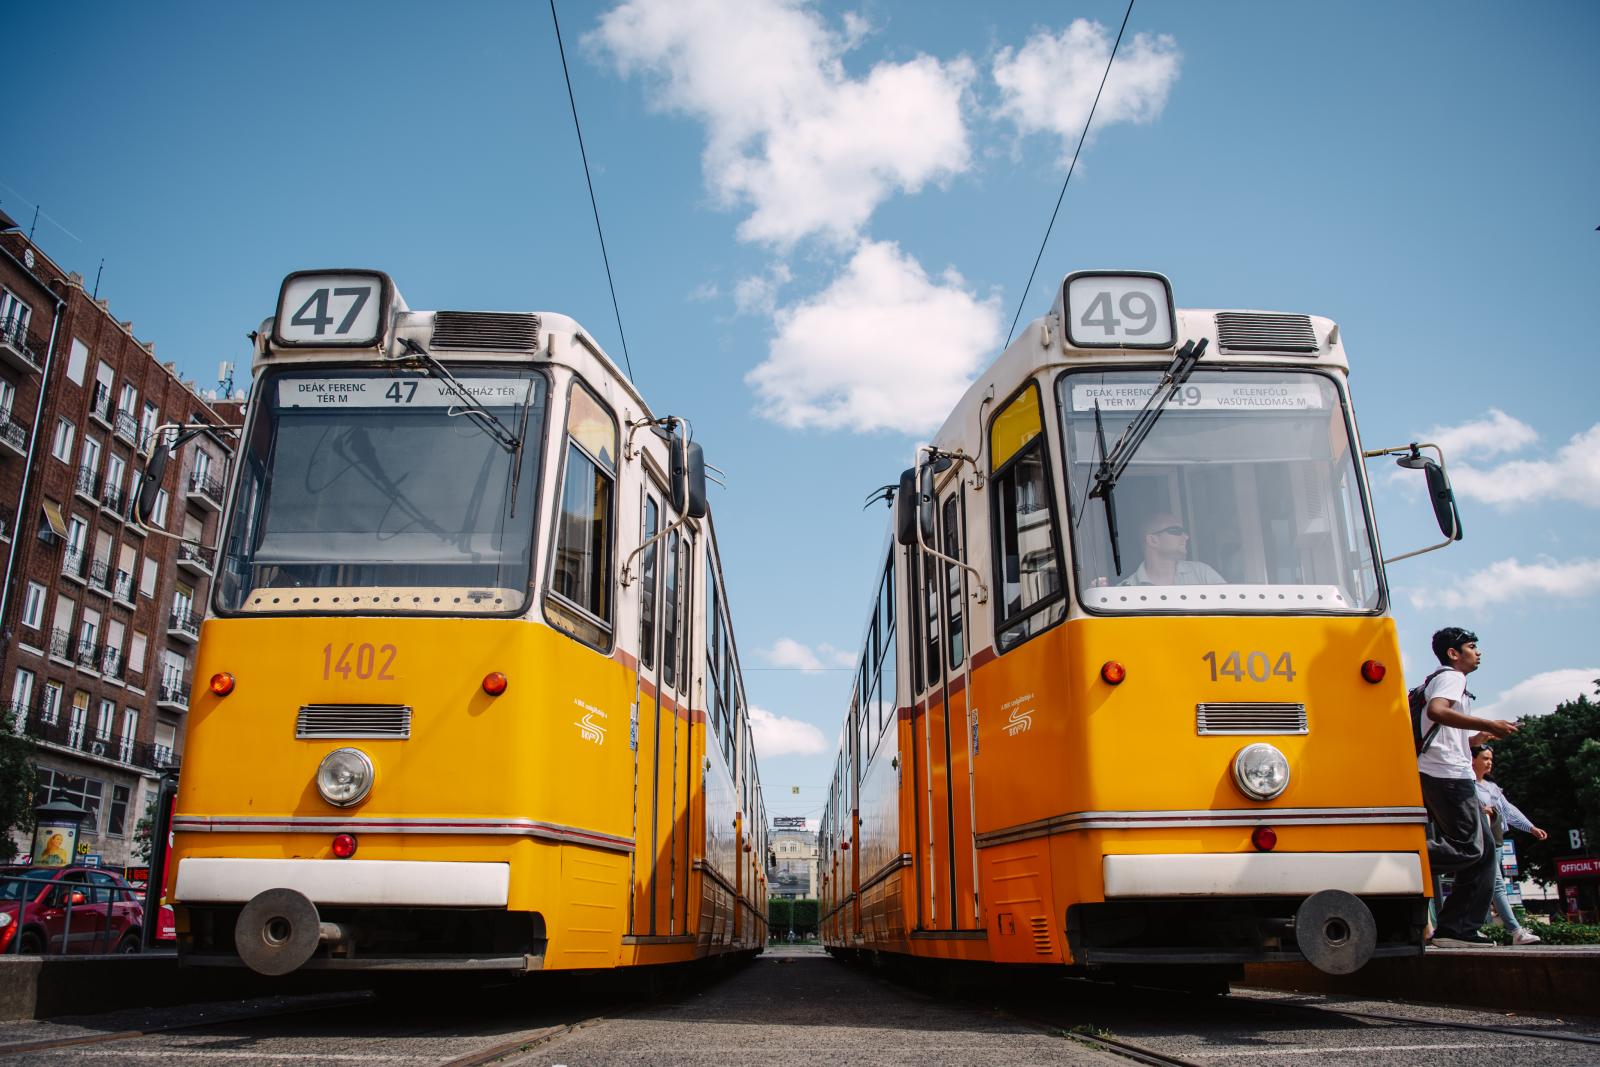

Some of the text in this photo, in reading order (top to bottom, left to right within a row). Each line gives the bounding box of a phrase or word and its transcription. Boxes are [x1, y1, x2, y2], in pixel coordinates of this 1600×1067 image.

[291, 286, 372, 335] 47
[1080, 291, 1157, 336] 49
[298, 382, 366, 392] DEÁK FERENC
[385, 381, 419, 403] 47
[496, 386, 515, 396] TÉR
[1086, 386, 1153, 397] DEÁK FERENC
[317, 393, 348, 403] TÉR M
[1105, 397, 1124, 407] TÉR
[1169, 386, 1202, 406] 49
[323, 642, 397, 681] 1402
[1202, 651, 1297, 682] 1404
[1561, 862, 1592, 873] OFFICIAL
